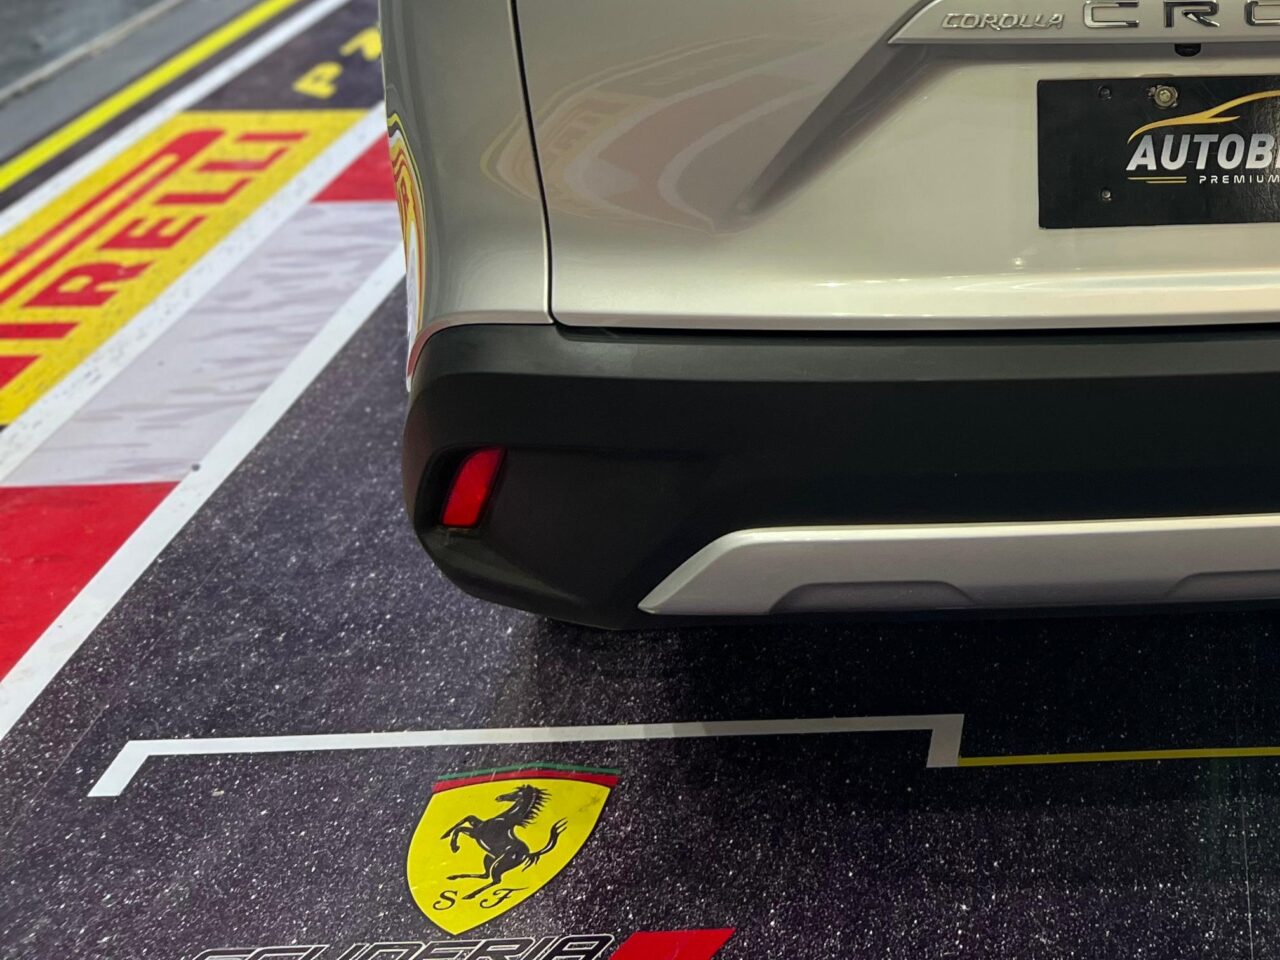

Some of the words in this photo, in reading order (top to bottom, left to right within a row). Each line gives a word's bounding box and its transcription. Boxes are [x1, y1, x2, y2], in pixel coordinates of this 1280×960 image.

[941, 12, 1065, 31] COROLLA
[1199, 174, 1280, 184] PREMIUM
[432, 889, 459, 911] S
